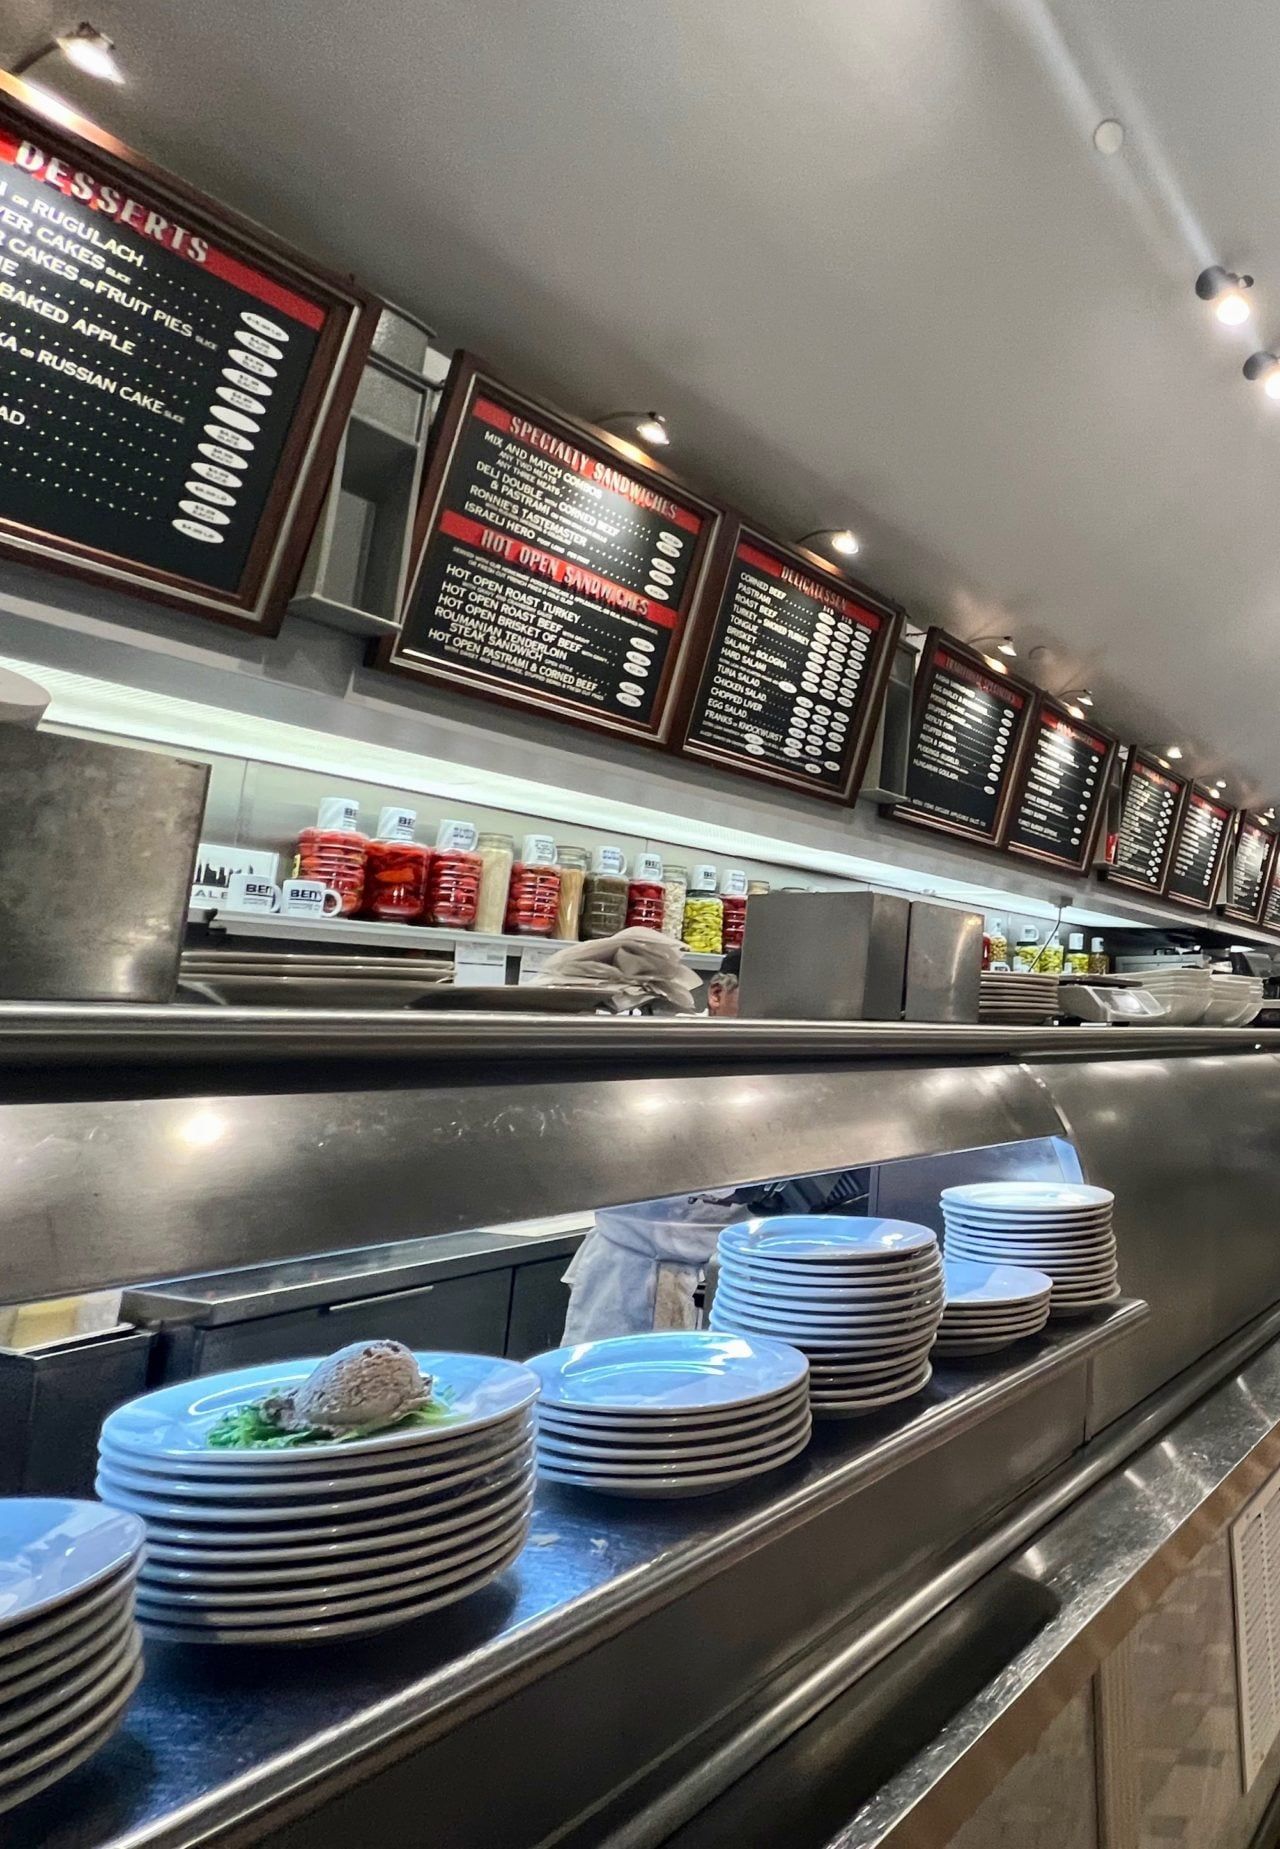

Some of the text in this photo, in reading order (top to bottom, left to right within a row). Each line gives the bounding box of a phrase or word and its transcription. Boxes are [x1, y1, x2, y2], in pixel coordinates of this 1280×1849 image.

[15, 140, 208, 263] DESSERTS
[32, 196, 143, 269] RUGULACH
[36, 224, 105, 273] CAKES
[3, 231, 79, 283] CAKES
[95, 278, 151, 318] FRUIT
[153, 307, 193, 339] PIES
[0, 280, 136, 357] BAKED APPLE
[37, 347, 115, 395] RUSSIAN
[118, 384, 164, 416] CAKE
[483, 430, 503, 448] MIX
[504, 441, 527, 461] AND
[528, 454, 562, 479] MATCH
[495, 458, 560, 496] ANY THREE MEATS
[498, 450, 556, 485] ANY TWO MEATS
[510, 417, 590, 474] SPECIALTY
[593, 463, 678, 520] SANDWICHES
[464, 500, 505, 526] ISRAELI
[506, 519, 535, 540] HERO
[469, 484, 519, 515] RONNIE'S
[520, 508, 587, 546] TASTEMASTER
[476, 460, 500, 479] DELI
[501, 472, 543, 500] DOUBLE
[558, 500, 596, 526] CORNED
[596, 519, 620, 538] BEEF
[490, 478, 499, 490] &
[500, 483, 550, 515] PASTRAMI
[446, 563, 471, 581] HOT
[472, 574, 503, 594] OPEN
[504, 586, 540, 608] ROAST
[541, 601, 581, 624] TURKEY
[479, 528, 514, 559] HOT
[517, 545, 559, 578] OPEN
[562, 565, 649, 616] SANDWICHES
[737, 582, 771, 605] PASTRAMI
[740, 571, 786, 601] CORNED BEEF
[780, 564, 848, 611] DELICATESSEN
[437, 593, 463, 610] HOT
[464, 603, 495, 622] OPEN
[496, 615, 539, 638] BRISKET
[541, 631, 556, 644] OF
[556, 637, 582, 654] BEEF
[441, 581, 466, 598] HOT
[467, 591, 498, 610] OPEN
[500, 603, 536, 624] ROAST
[537, 617, 563, 634] BEEF
[729, 614, 758, 633] TONGUE
[734, 592, 777, 619] ROAST BEEF
[434, 605, 502, 638] ROUMANIAN
[504, 631, 567, 661] TENDERLOIN
[449, 621, 486, 642] STEAK
[487, 635, 543, 662] SANDWICH
[726, 625, 756, 644] BRISKET
[427, 628, 451, 644] HOT
[451, 636, 480, 654] OPEN
[481, 646, 529, 670] PASTRAMI
[529, 662, 538, 673] &
[538, 665, 574, 685] CORNED
[575, 677, 598, 692] BEEF
[716, 664, 737, 678] TUNA
[737, 672, 760, 687] SALAD
[707, 698, 747, 718] EGG SALAD
[710, 686, 762, 711] CHOPPED LIVER
[713, 675, 766, 701] CHICKEN SALAD
